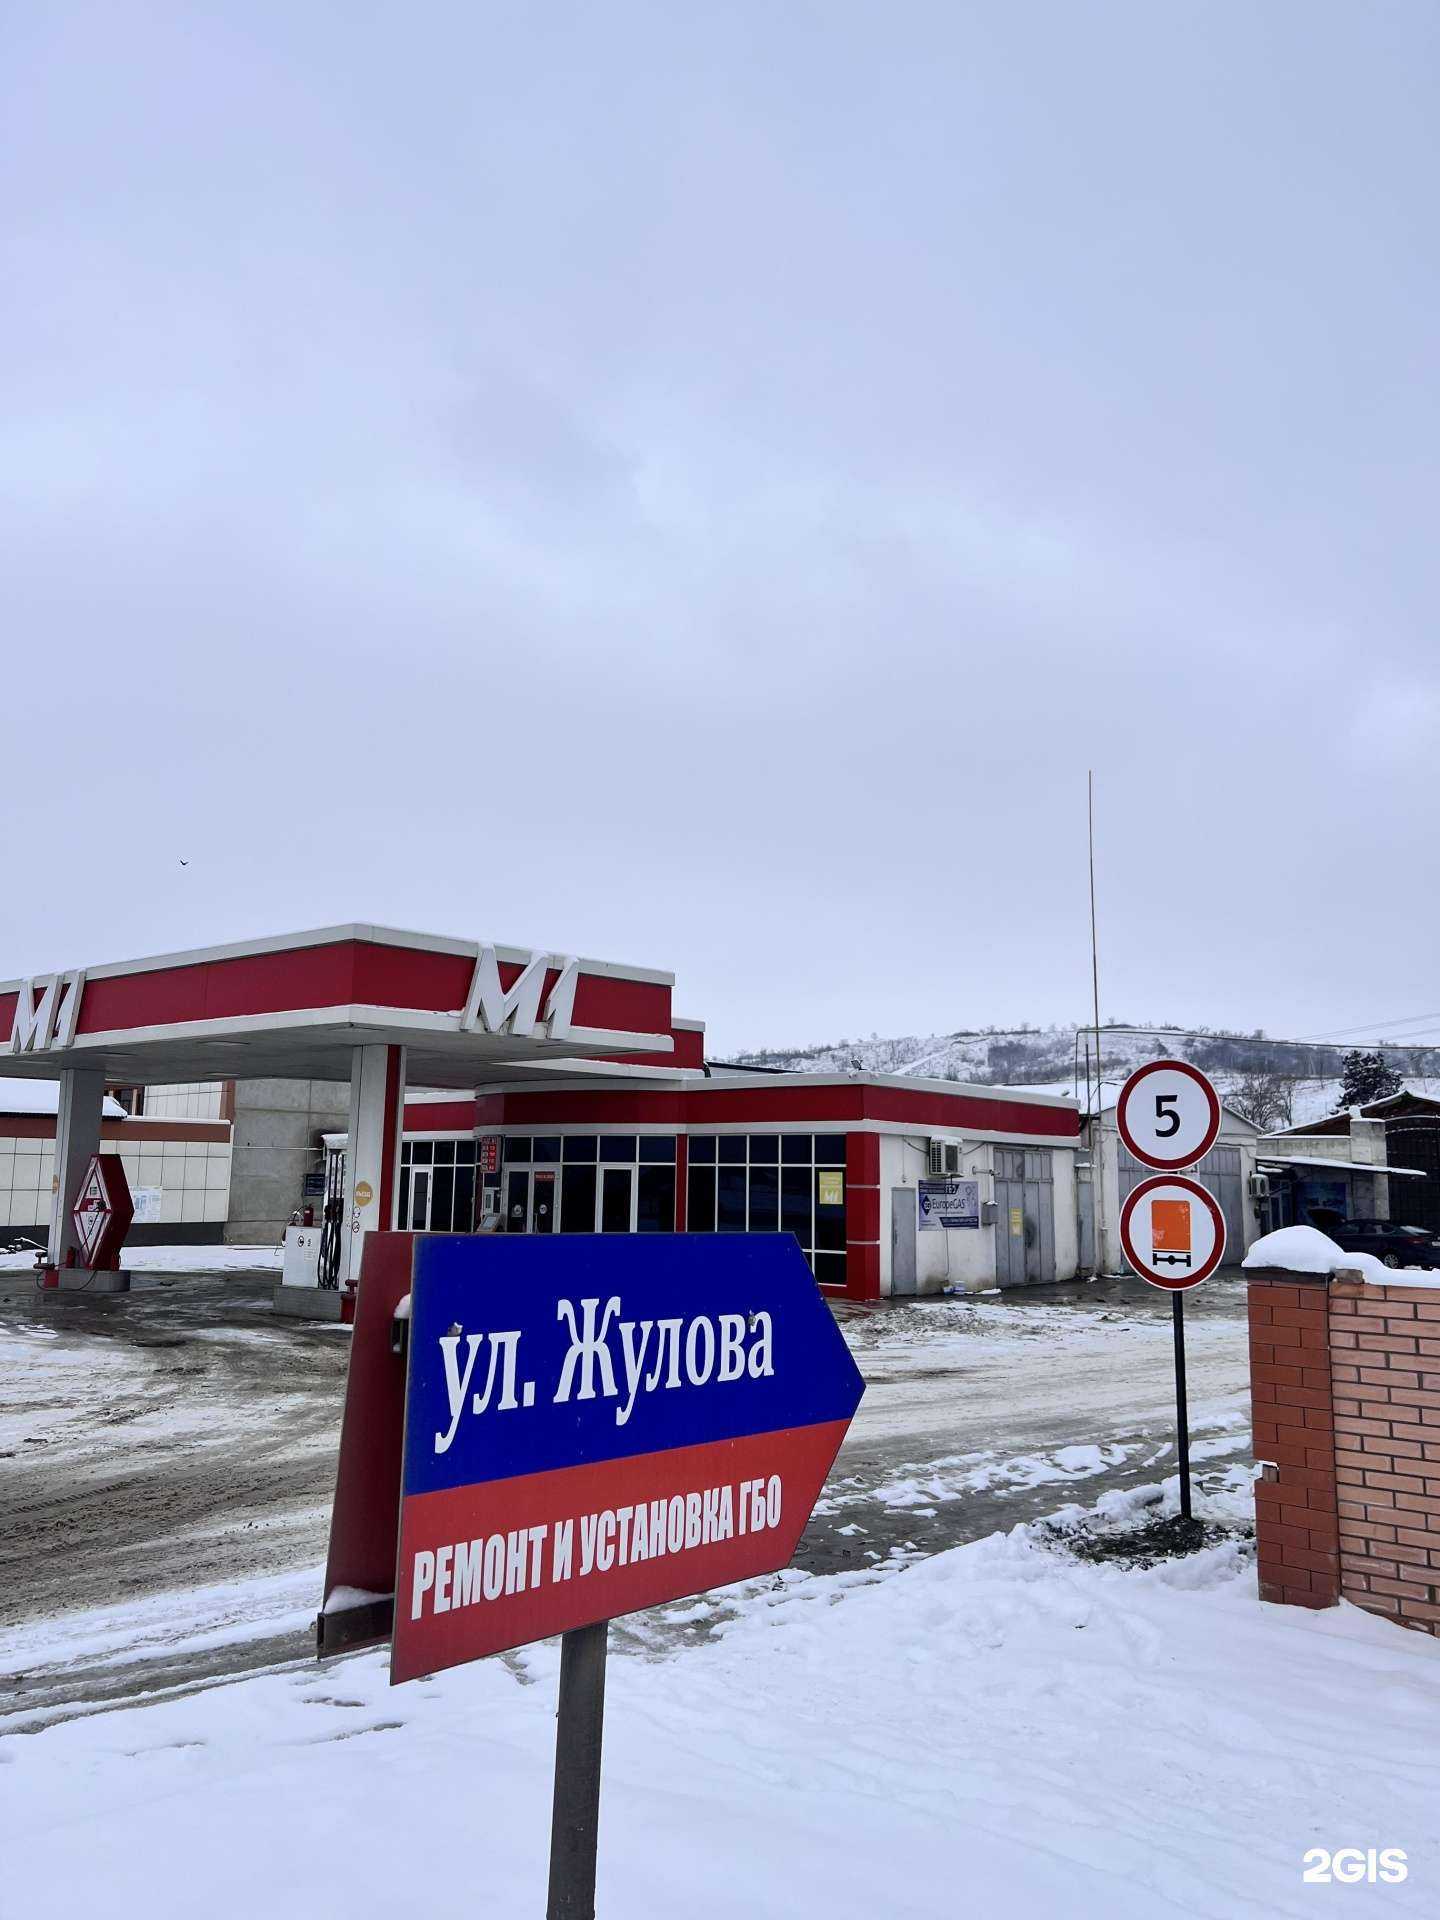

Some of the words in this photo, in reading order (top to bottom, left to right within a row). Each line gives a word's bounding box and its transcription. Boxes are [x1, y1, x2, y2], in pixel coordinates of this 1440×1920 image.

[1155, 1094, 1180, 1138] 5
[434, 1331, 536, 1454] ул.
[553, 1296, 775, 1426] Жулова
[411, 1524, 548, 1620] РЕМОНТ
[551, 1519, 574, 1583] И
[579, 1484, 733, 1576] УСТАНОВКА
[738, 1474, 783, 1536] ГБО
